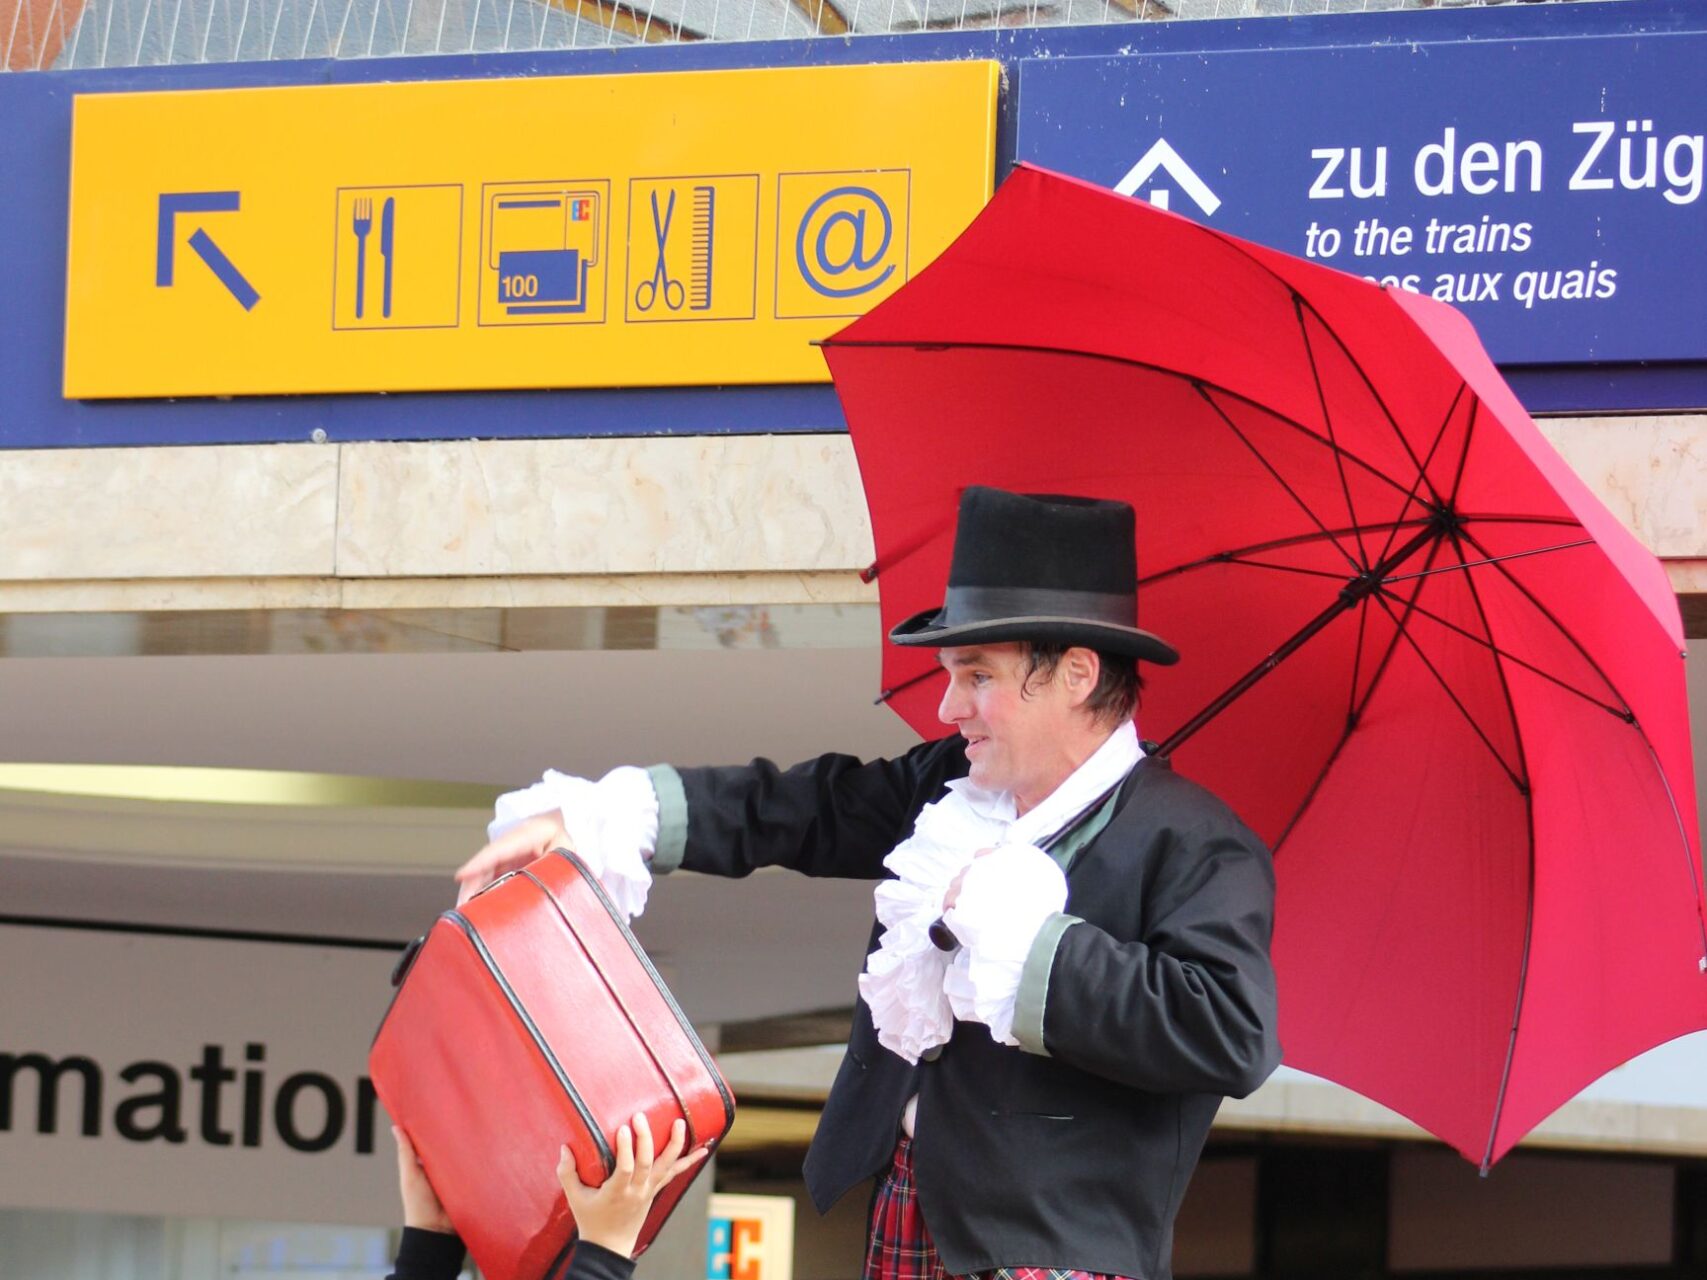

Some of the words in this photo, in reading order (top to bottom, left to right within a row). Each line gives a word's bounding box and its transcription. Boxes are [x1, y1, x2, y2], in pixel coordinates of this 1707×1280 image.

[1308, 146, 1387, 199] zu
[1414, 127, 1542, 197] den
[1568, 119, 1704, 205] Züg
[1304, 222, 1341, 257] to
[1353, 218, 1413, 256] the
[1425, 215, 1533, 254] trains
[502, 274, 538, 298] 100
[1431, 271, 1503, 302] aux
[1512, 260, 1618, 309] quais
